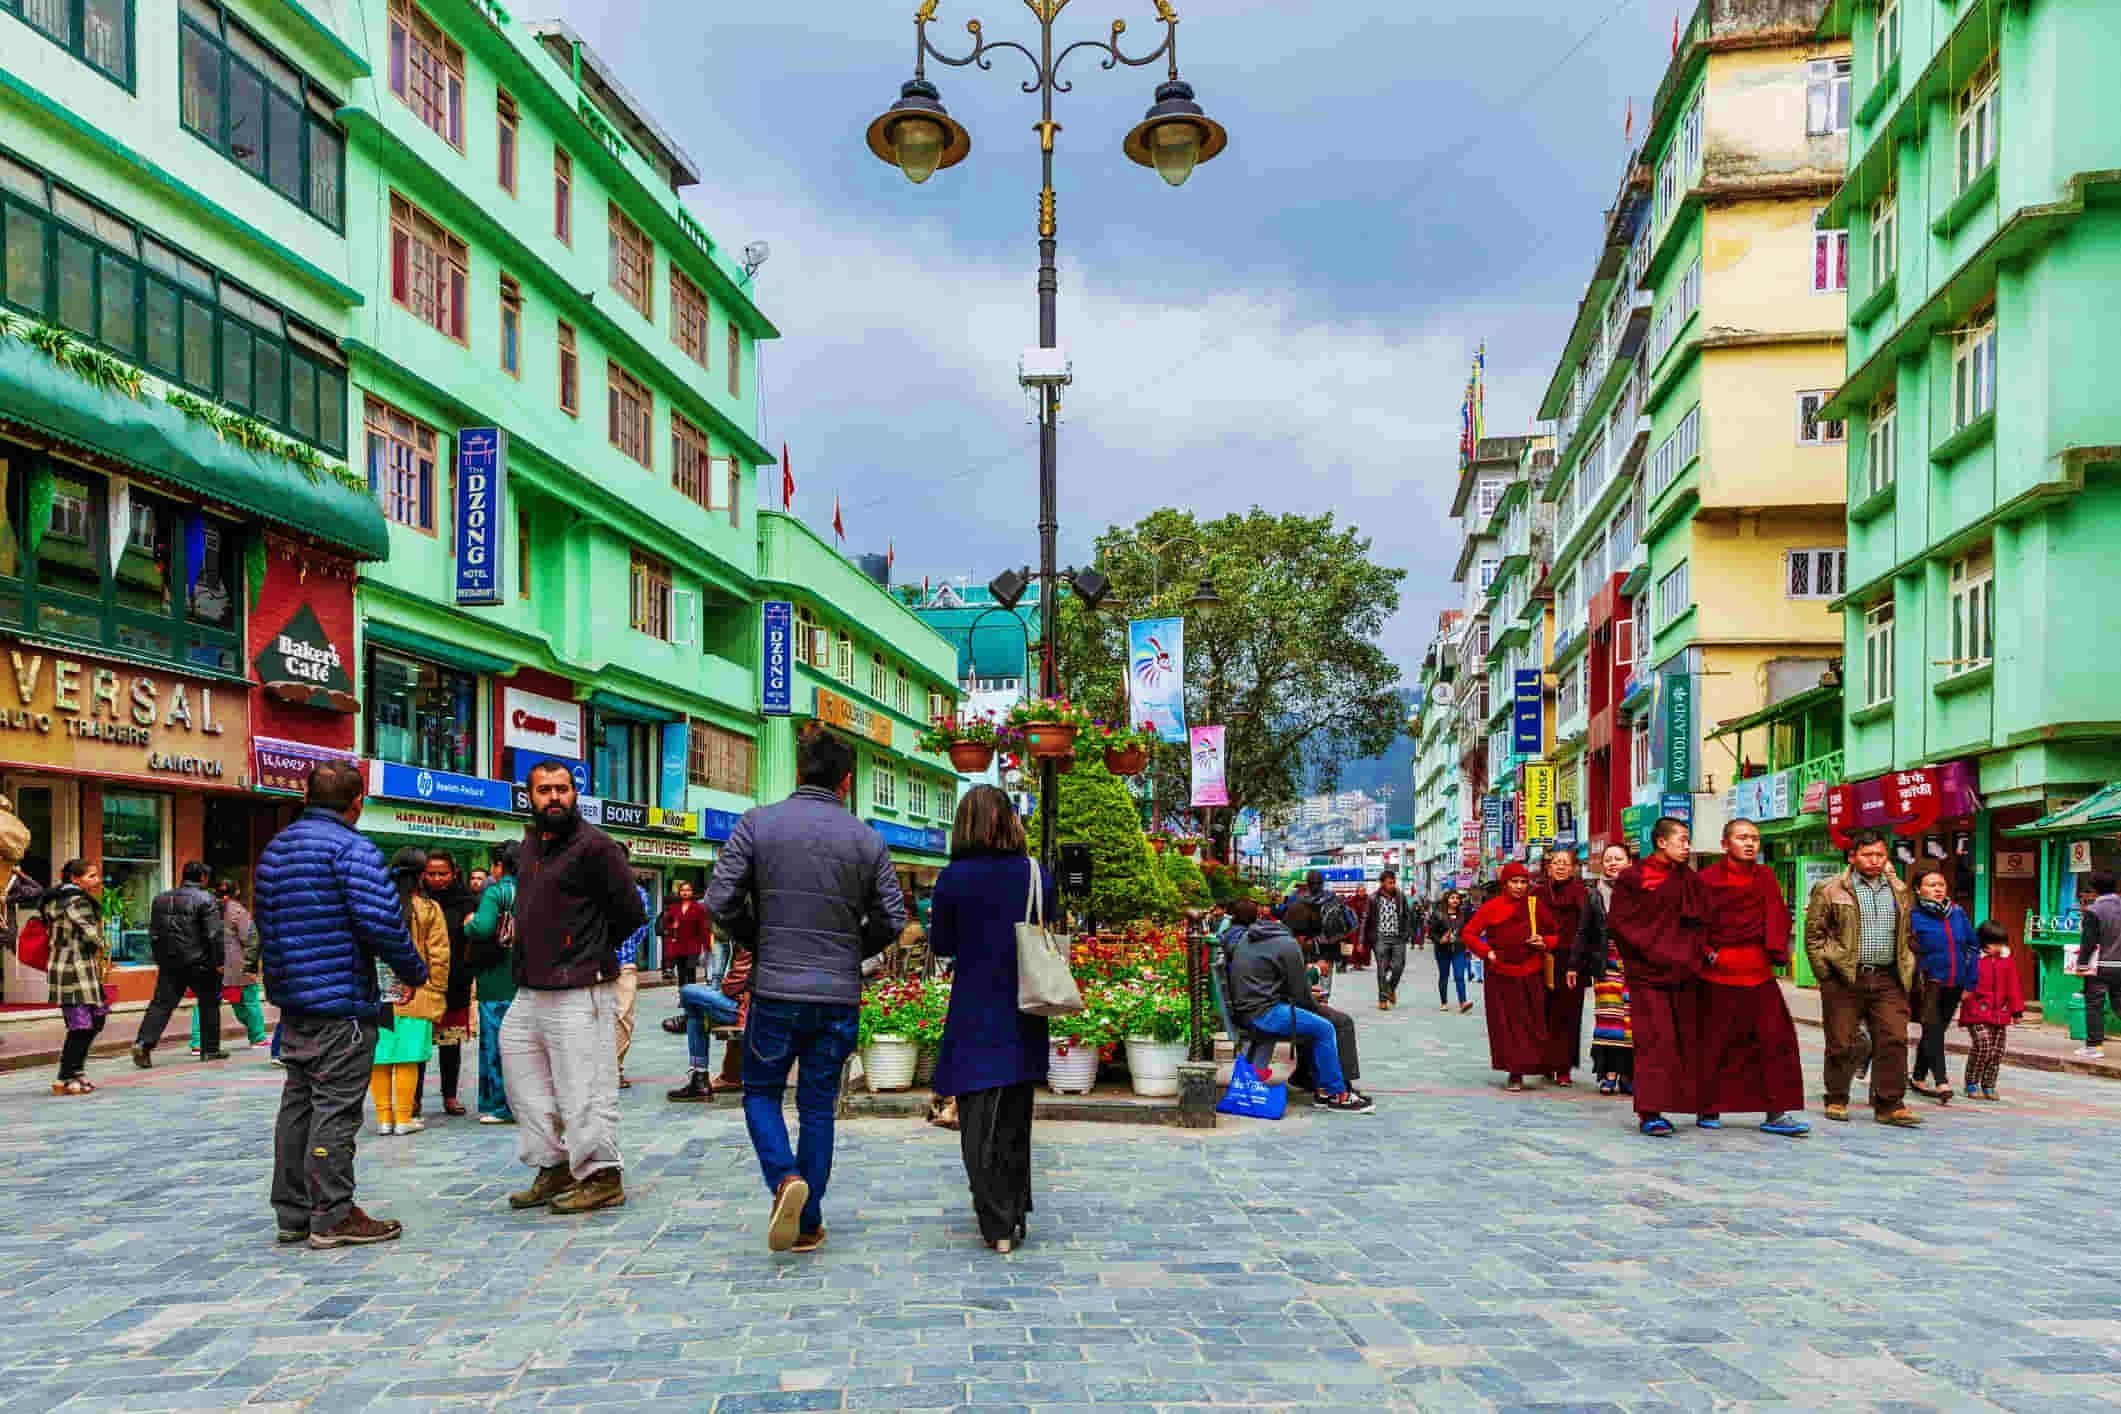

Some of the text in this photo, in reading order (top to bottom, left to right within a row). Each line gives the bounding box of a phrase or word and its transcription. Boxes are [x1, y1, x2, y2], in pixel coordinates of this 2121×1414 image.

[467, 474, 486, 564] DZONG
[279, 635, 340, 667] Baker's
[771, 631, 784, 688] DZONG
[11, 650, 224, 735] VERSAL
[1673, 703, 1688, 784] WOODLAND
[607, 806, 641, 824] SONY
[1537, 769, 1548, 808] house
